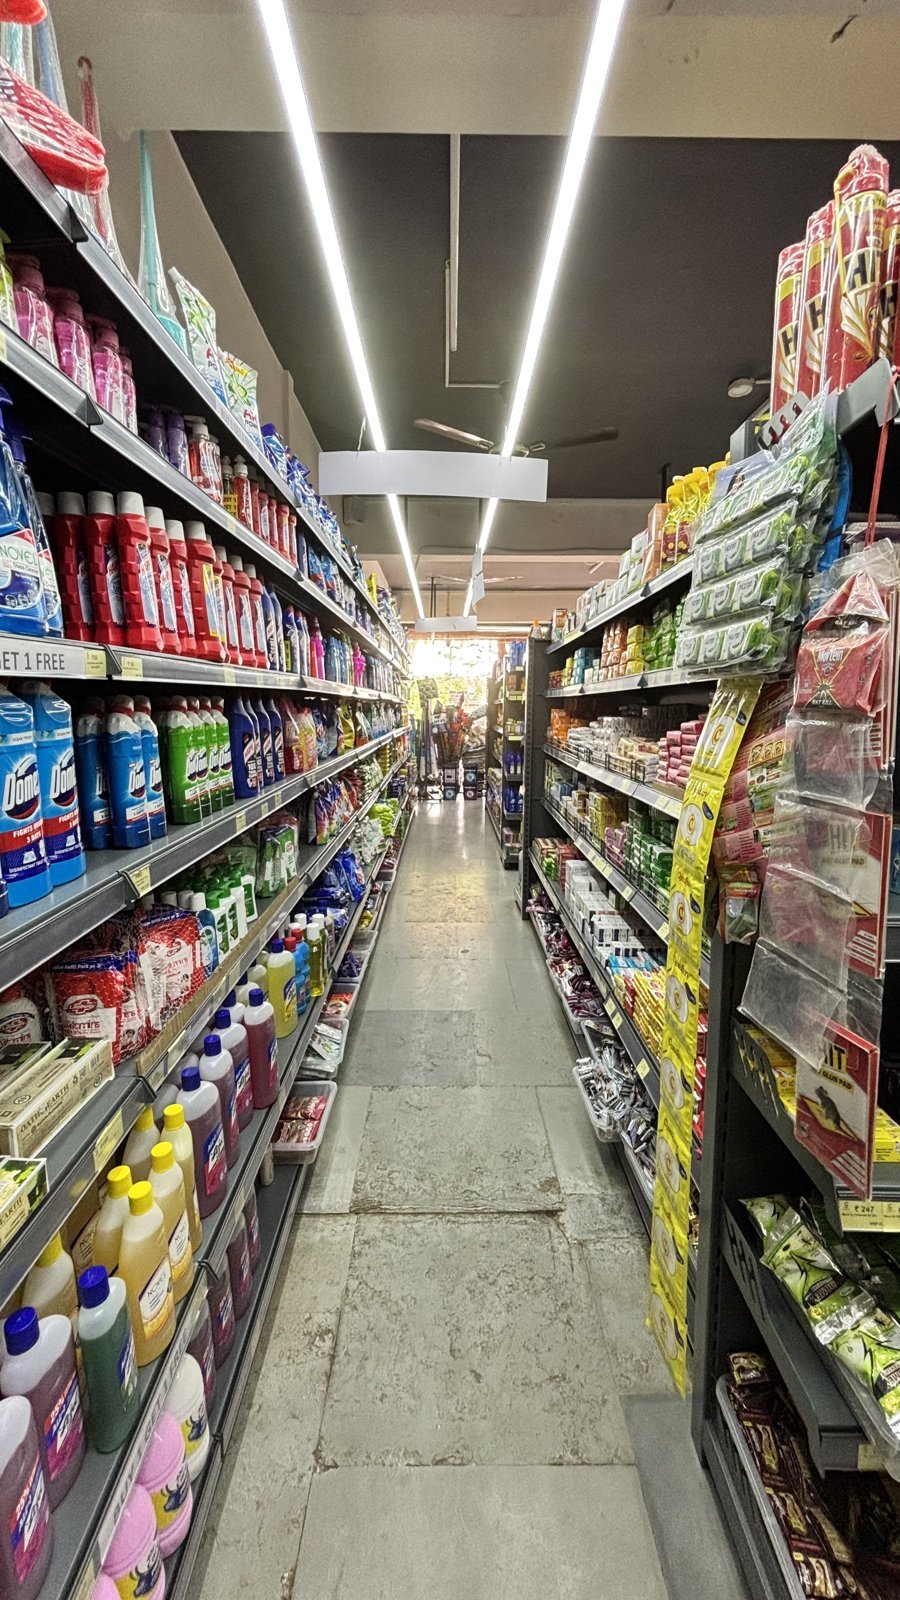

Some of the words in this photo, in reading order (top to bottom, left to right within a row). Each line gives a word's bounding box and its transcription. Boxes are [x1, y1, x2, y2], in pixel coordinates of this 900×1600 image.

[0, 651, 19, 671] ET
[24, 652, 32, 671] 1
[36, 652, 66, 671] FREE
[12, 824, 34, 839] FIGHTS
[822, 1069, 838, 1085] GLUE
[838, 1075, 852, 1091] PAD
[861, 1205, 874, 1213] 247
